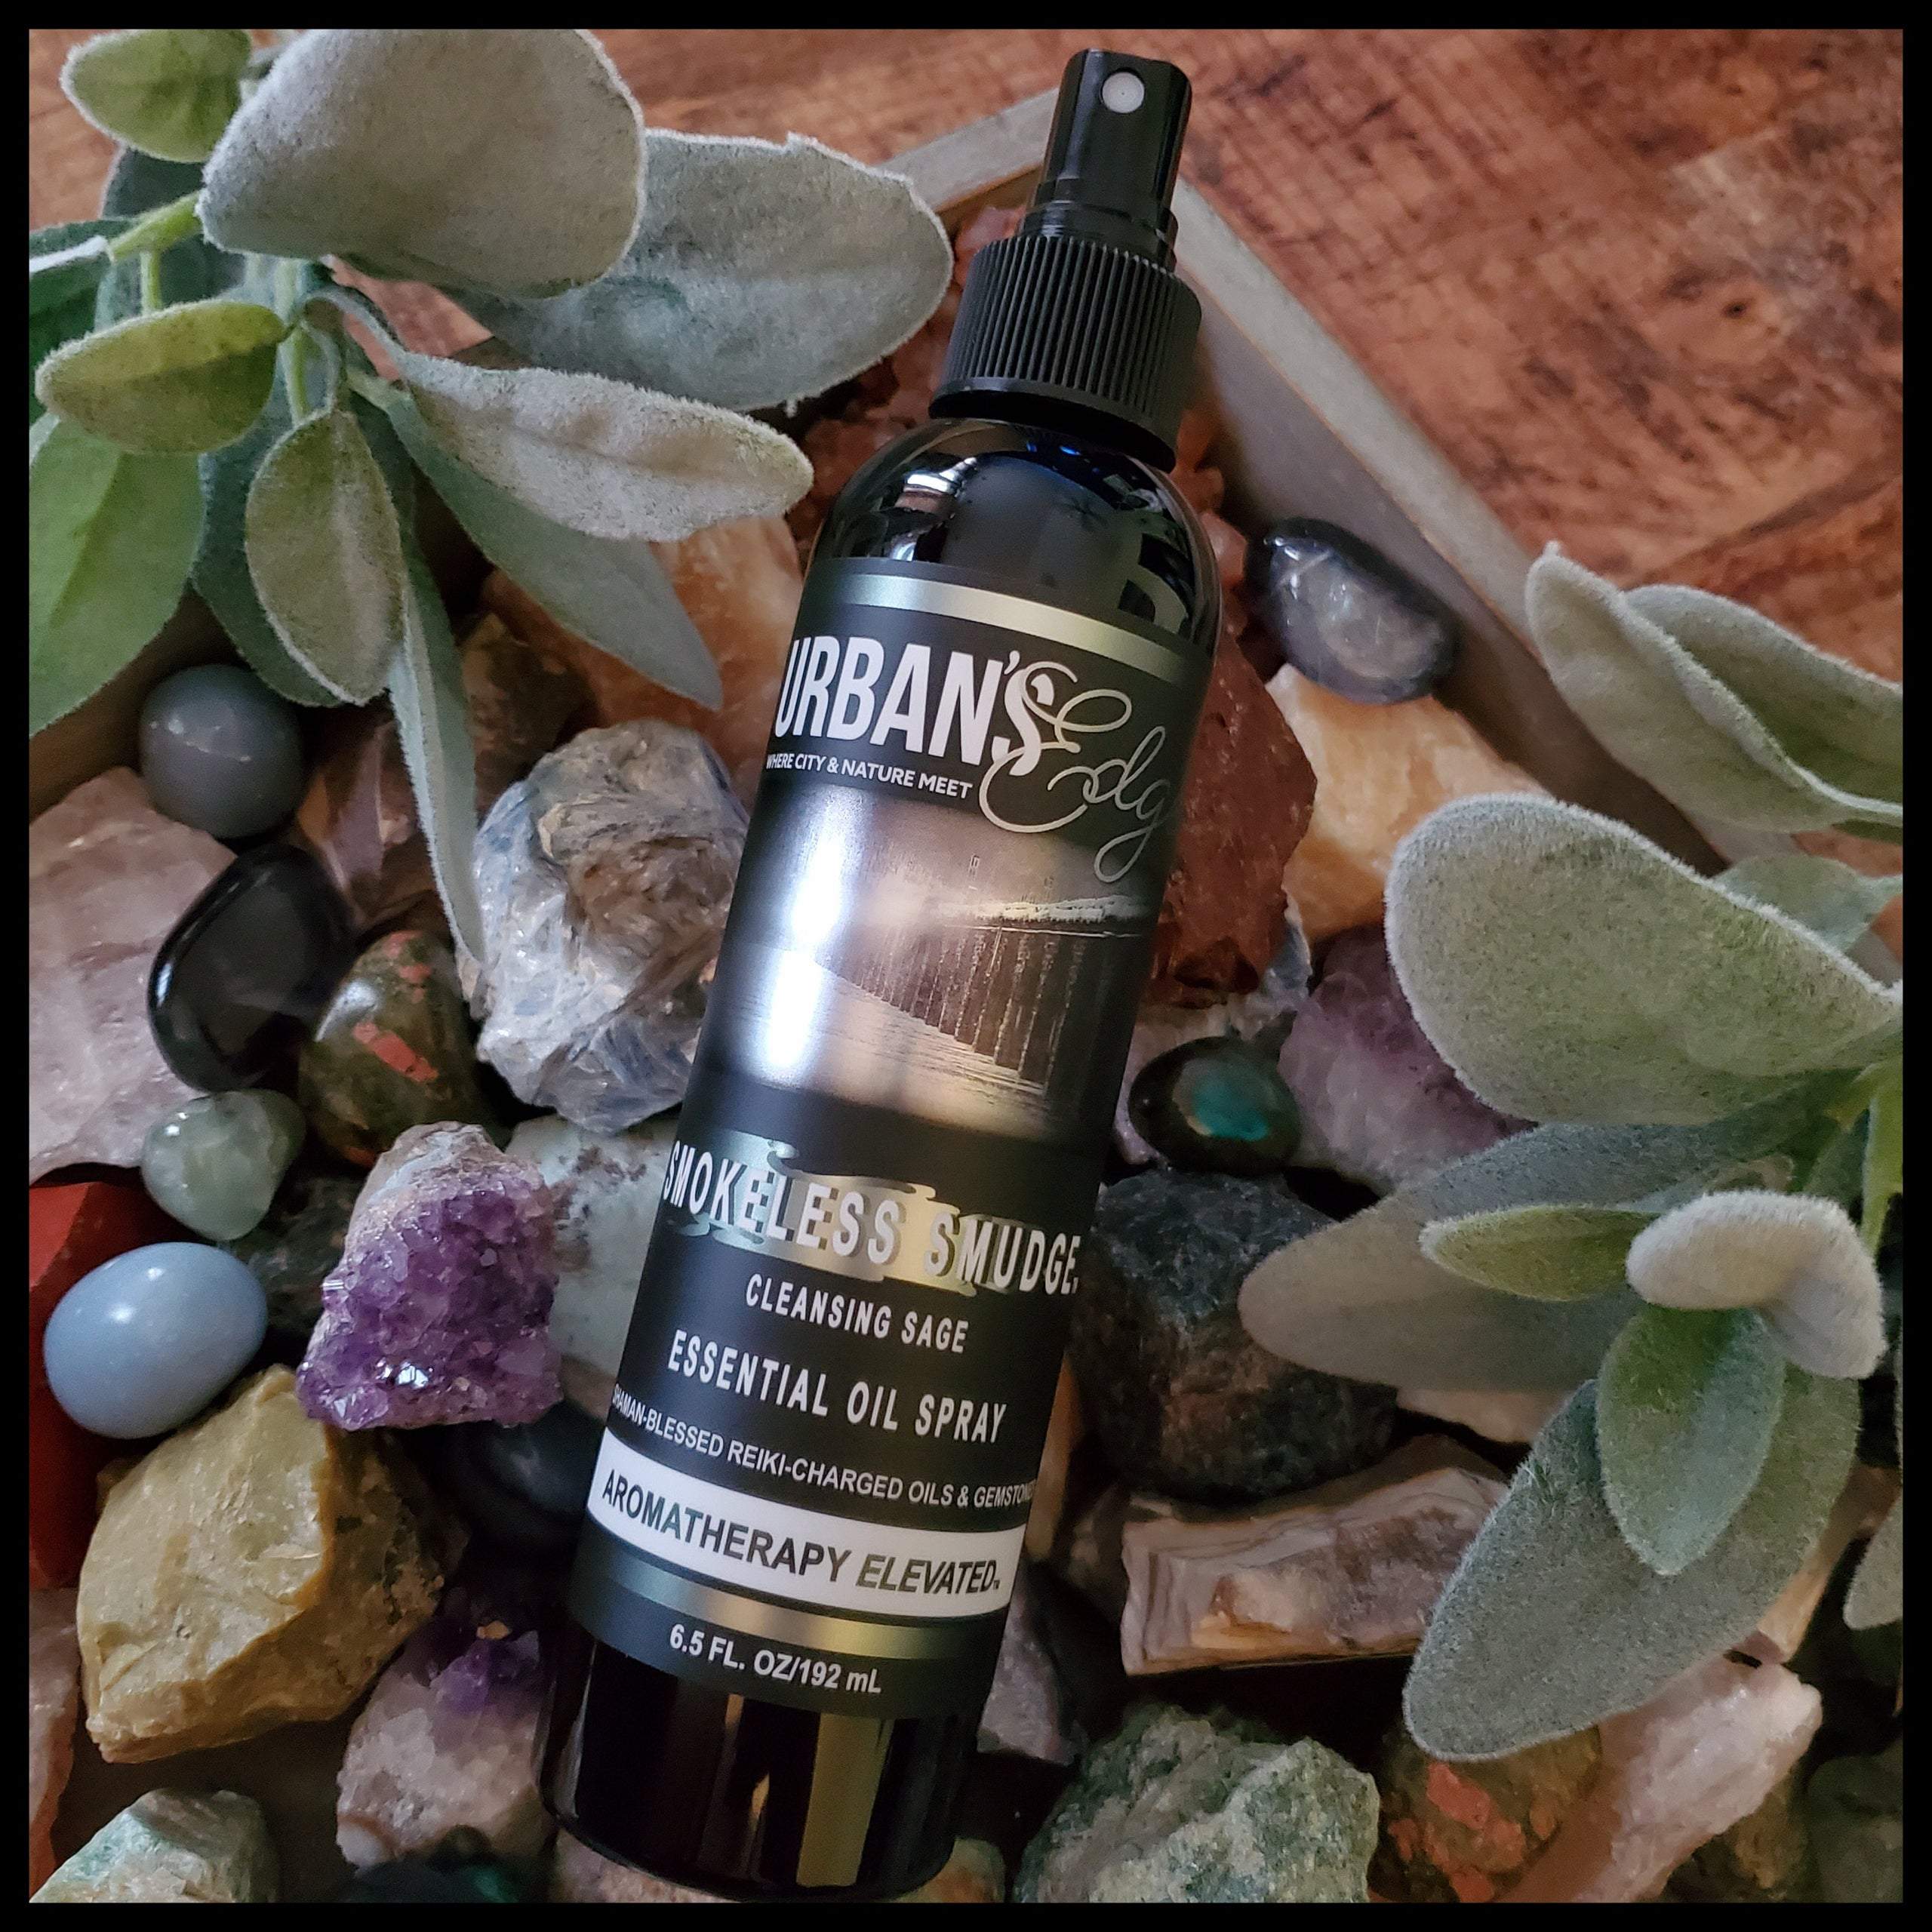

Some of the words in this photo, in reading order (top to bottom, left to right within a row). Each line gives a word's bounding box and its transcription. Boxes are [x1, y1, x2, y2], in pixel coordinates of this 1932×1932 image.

[774, 635, 1054, 776] URBAN'S
[766, 753, 795, 769] WHERE
[795, 753, 827, 771] CITY
[826, 756, 839, 774] &
[841, 758, 915, 788] NATURE
[918, 773, 974, 800] MEET
[980, 661, 1171, 882] Edg
[663, 1140, 903, 1265] SMOKELESS
[746, 1274, 891, 1339] CLEANSING
[901, 1311, 969, 1353] SAGE
[667, 1329, 829, 1417] ESSENTIAL
[846, 1380, 899, 1432] OIL
[915, 1394, 1008, 1443] SPRAY
[601, 1468, 852, 1583] AROMATHERAPY
[728, 1443, 903, 1500] REIKI-CHARGED
[908, 1480, 953, 1508] OILS
[957, 1486, 969, 1508] &
[669, 1624, 703, 1657] 6.5
[708, 1637, 745, 1671] FL.
[754, 1648, 842, 1690] OZ/192
[846, 1668, 882, 1694] mL
